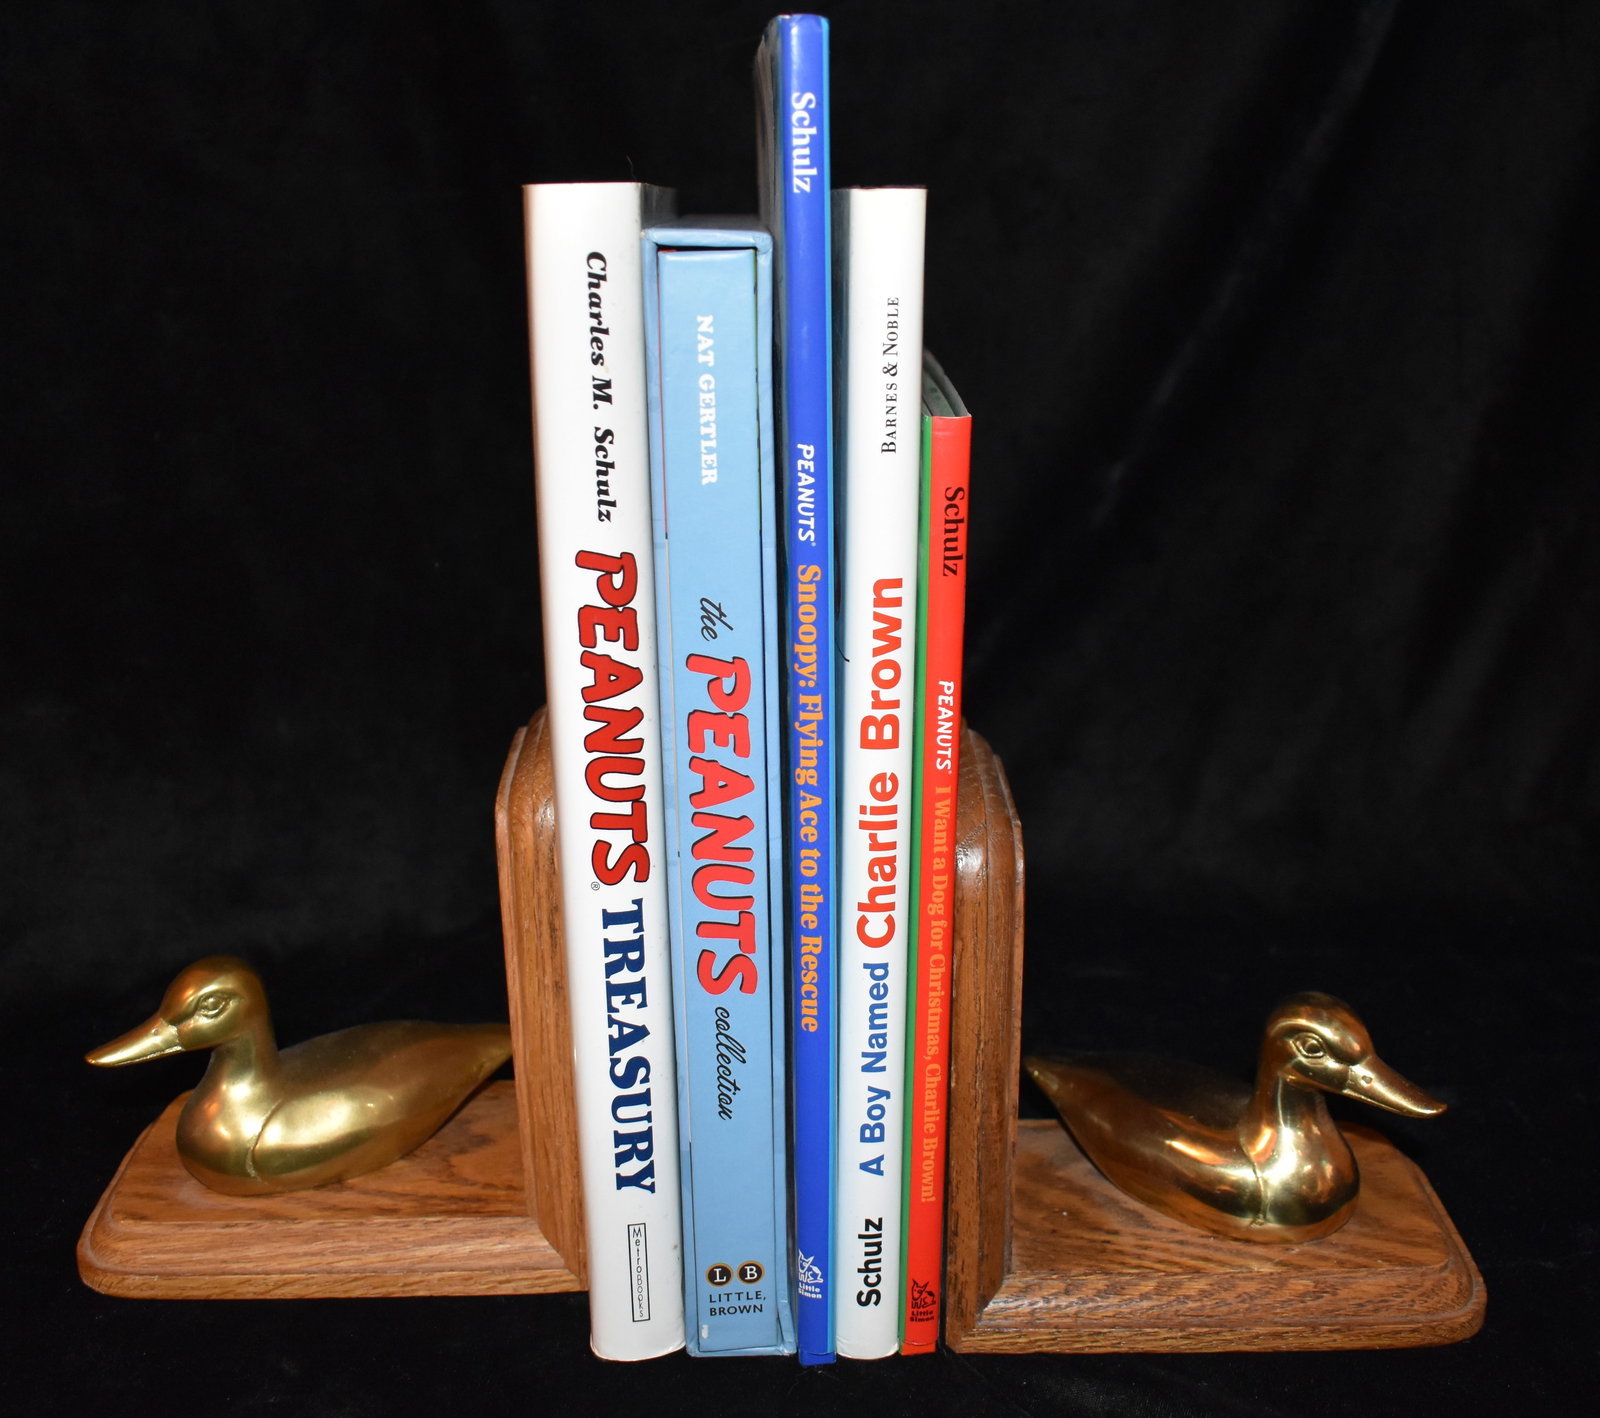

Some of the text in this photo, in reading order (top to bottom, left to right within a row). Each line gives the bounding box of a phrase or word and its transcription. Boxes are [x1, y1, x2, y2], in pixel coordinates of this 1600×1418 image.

[792, 92, 817, 193] Schulz
[587, 251, 617, 522] Charles M. Schulz
[696, 315, 718, 485] NAT GERTLER
[881, 297, 899, 454] BARNES & NOBLE
[943, 486, 965, 576] Schulz
[794, 564, 822, 688] Snoopy:
[794, 694, 823, 787] Flying
[686, 597, 758, 1121] the PEANUTS collection
[799, 790, 823, 842] Ace
[932, 798, 950, 853] Want
[799, 848, 822, 877] to
[800, 882, 824, 930] the
[856, 578, 903, 1176] A Boy Named Charlie Brown
[927, 873, 948, 915] Dog
[932, 859, 946, 870] a
[930, 919, 947, 952] for
[800, 935, 823, 1032] Rescue
[925, 953, 946, 1060] Christmas,
[602, 898, 655, 1194] TREASURY
[923, 1063, 941, 1133] Charlie
[921, 1137, 939, 1202] Brown!
[709, 1290, 767, 1304] LITTLE,
[713, 1265, 758, 1283] L B
[857, 1217, 884, 1307] Schulz
[709, 1304, 763, 1316] BROWN
